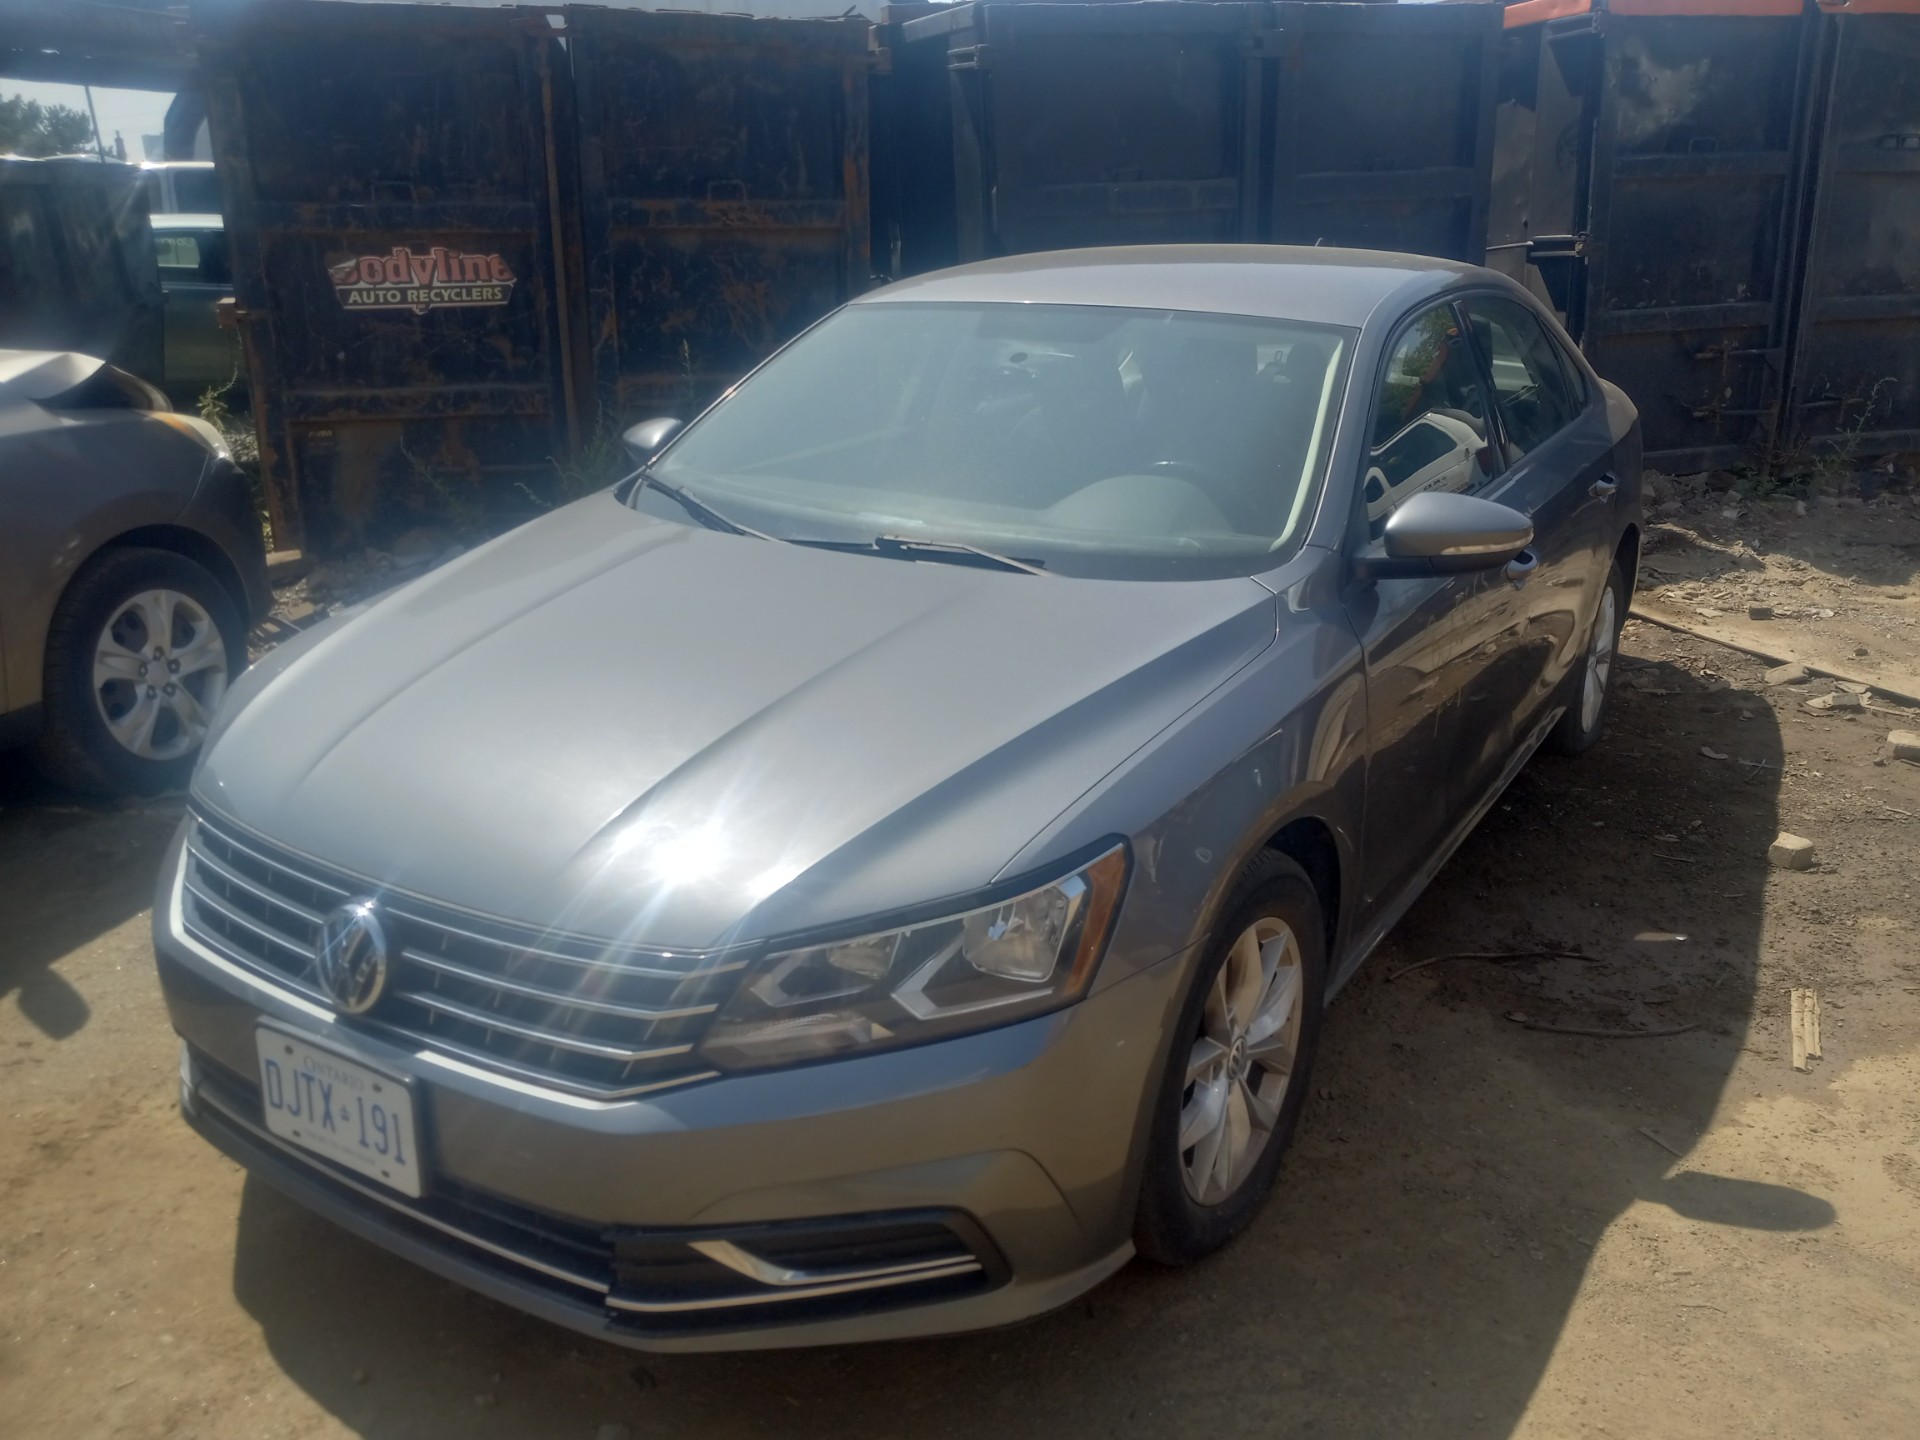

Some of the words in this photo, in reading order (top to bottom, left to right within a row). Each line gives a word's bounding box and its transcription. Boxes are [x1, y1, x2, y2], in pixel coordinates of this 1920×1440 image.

[348, 289, 401, 304] AUTO
[407, 286, 503, 302] RECYCLERS
[264, 1058, 337, 1134] DJTX
[356, 1096, 406, 1166] 191
